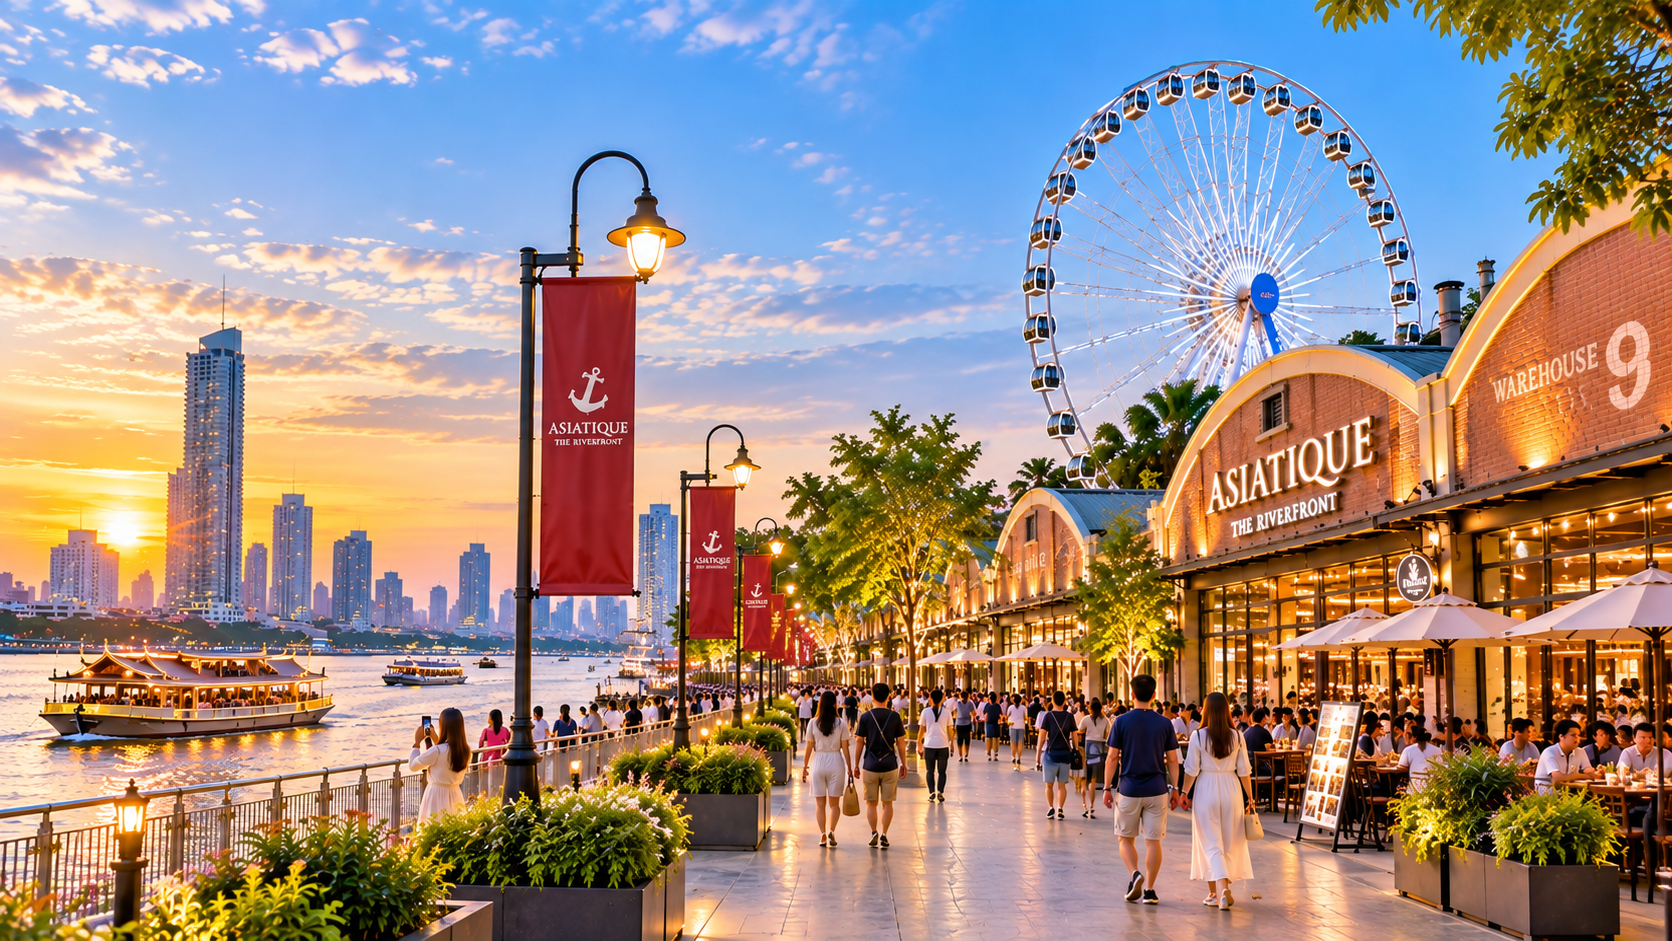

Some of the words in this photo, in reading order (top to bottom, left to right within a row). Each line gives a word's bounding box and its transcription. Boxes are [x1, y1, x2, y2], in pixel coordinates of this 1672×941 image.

[1492, 342, 1599, 404] WAREHOUSE
[1605, 320, 1652, 410] 9
[548, 421, 629, 437] ASIATIQUE
[1206, 415, 1374, 515] ASIATIQUE
[1230, 516, 1254, 538] THE
[1255, 491, 1338, 532] RIVERFRONT
